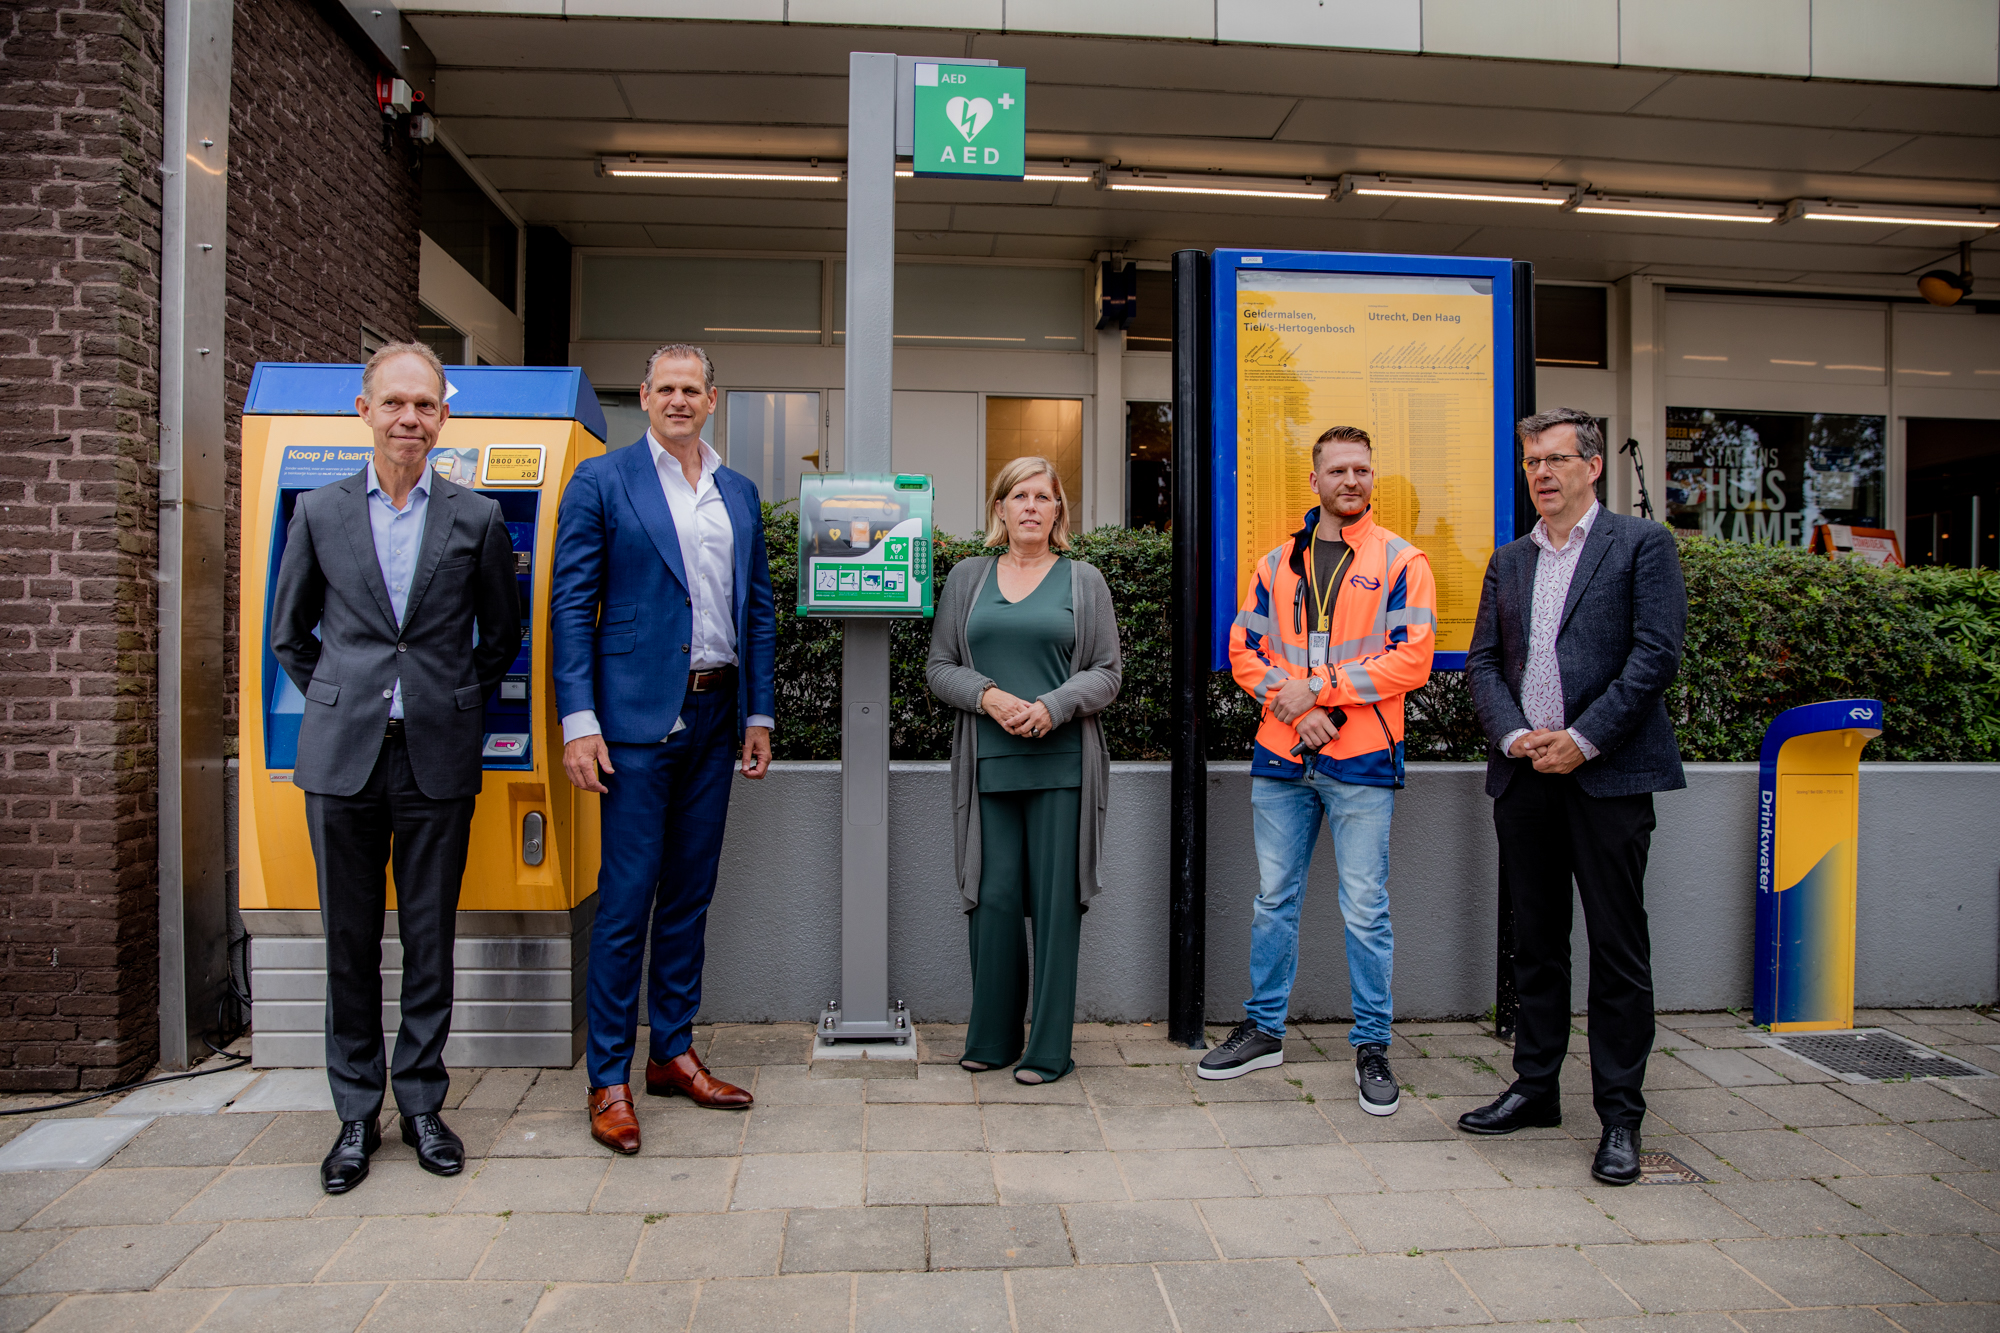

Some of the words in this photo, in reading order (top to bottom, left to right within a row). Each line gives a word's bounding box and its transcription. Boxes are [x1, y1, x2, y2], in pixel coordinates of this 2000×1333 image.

[941, 74, 966, 84] AED
[940, 146, 1000, 165] AED
[1244, 309, 1316, 320] Geldermalsen,
[1369, 312, 1409, 322] Utrecht,
[1413, 313, 1431, 321] Den
[1435, 313, 1461, 324] Haag
[1244, 323, 1355, 334] Tiel/'s-Hertogenbosch
[288, 450, 320, 462] Koop
[322, 450, 334, 462] je
[338, 450, 373, 462] kaartj
[1706, 446, 1779, 468] STATNS
[1706, 468, 1786, 511] HUIS
[874, 530, 889, 540] AE
[1706, 511, 1803, 549] KAME
[1760, 790, 1773, 893] Drinkwater
